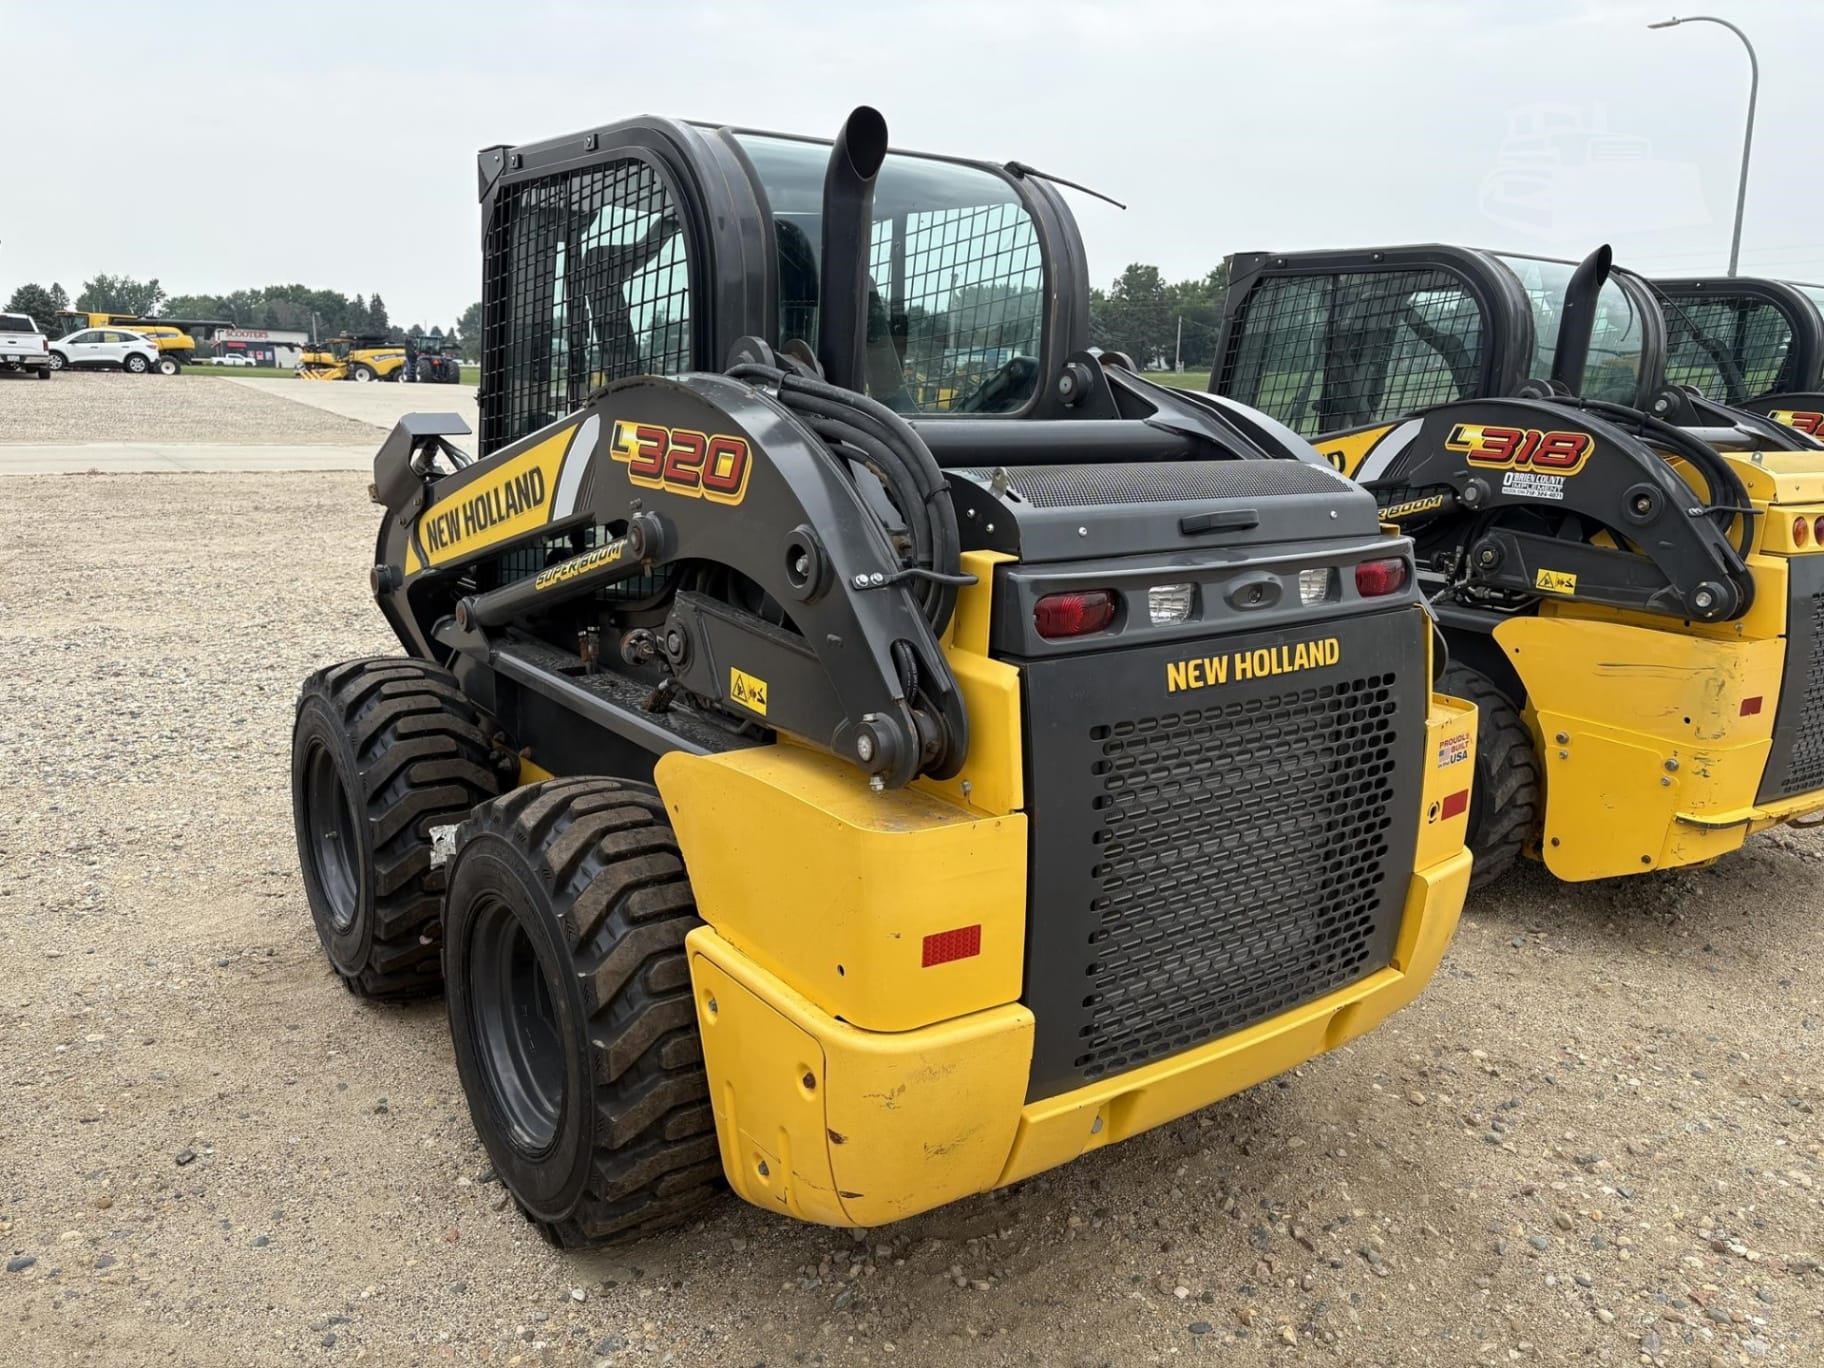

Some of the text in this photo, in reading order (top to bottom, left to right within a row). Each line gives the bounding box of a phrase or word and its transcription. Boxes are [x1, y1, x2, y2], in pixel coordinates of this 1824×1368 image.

[611, 420, 752, 505] L320
[1445, 423, 1595, 476] L318
[1536, 474, 1566, 485] COUNTY
[426, 466, 545, 553] NEW HOLLAND
[1387, 495, 1443, 519] BOOM
[1166, 637, 1340, 693] NEW HOLLAND
[1450, 741, 1469, 753] BUILT
[1450, 750, 1467, 763] USA
